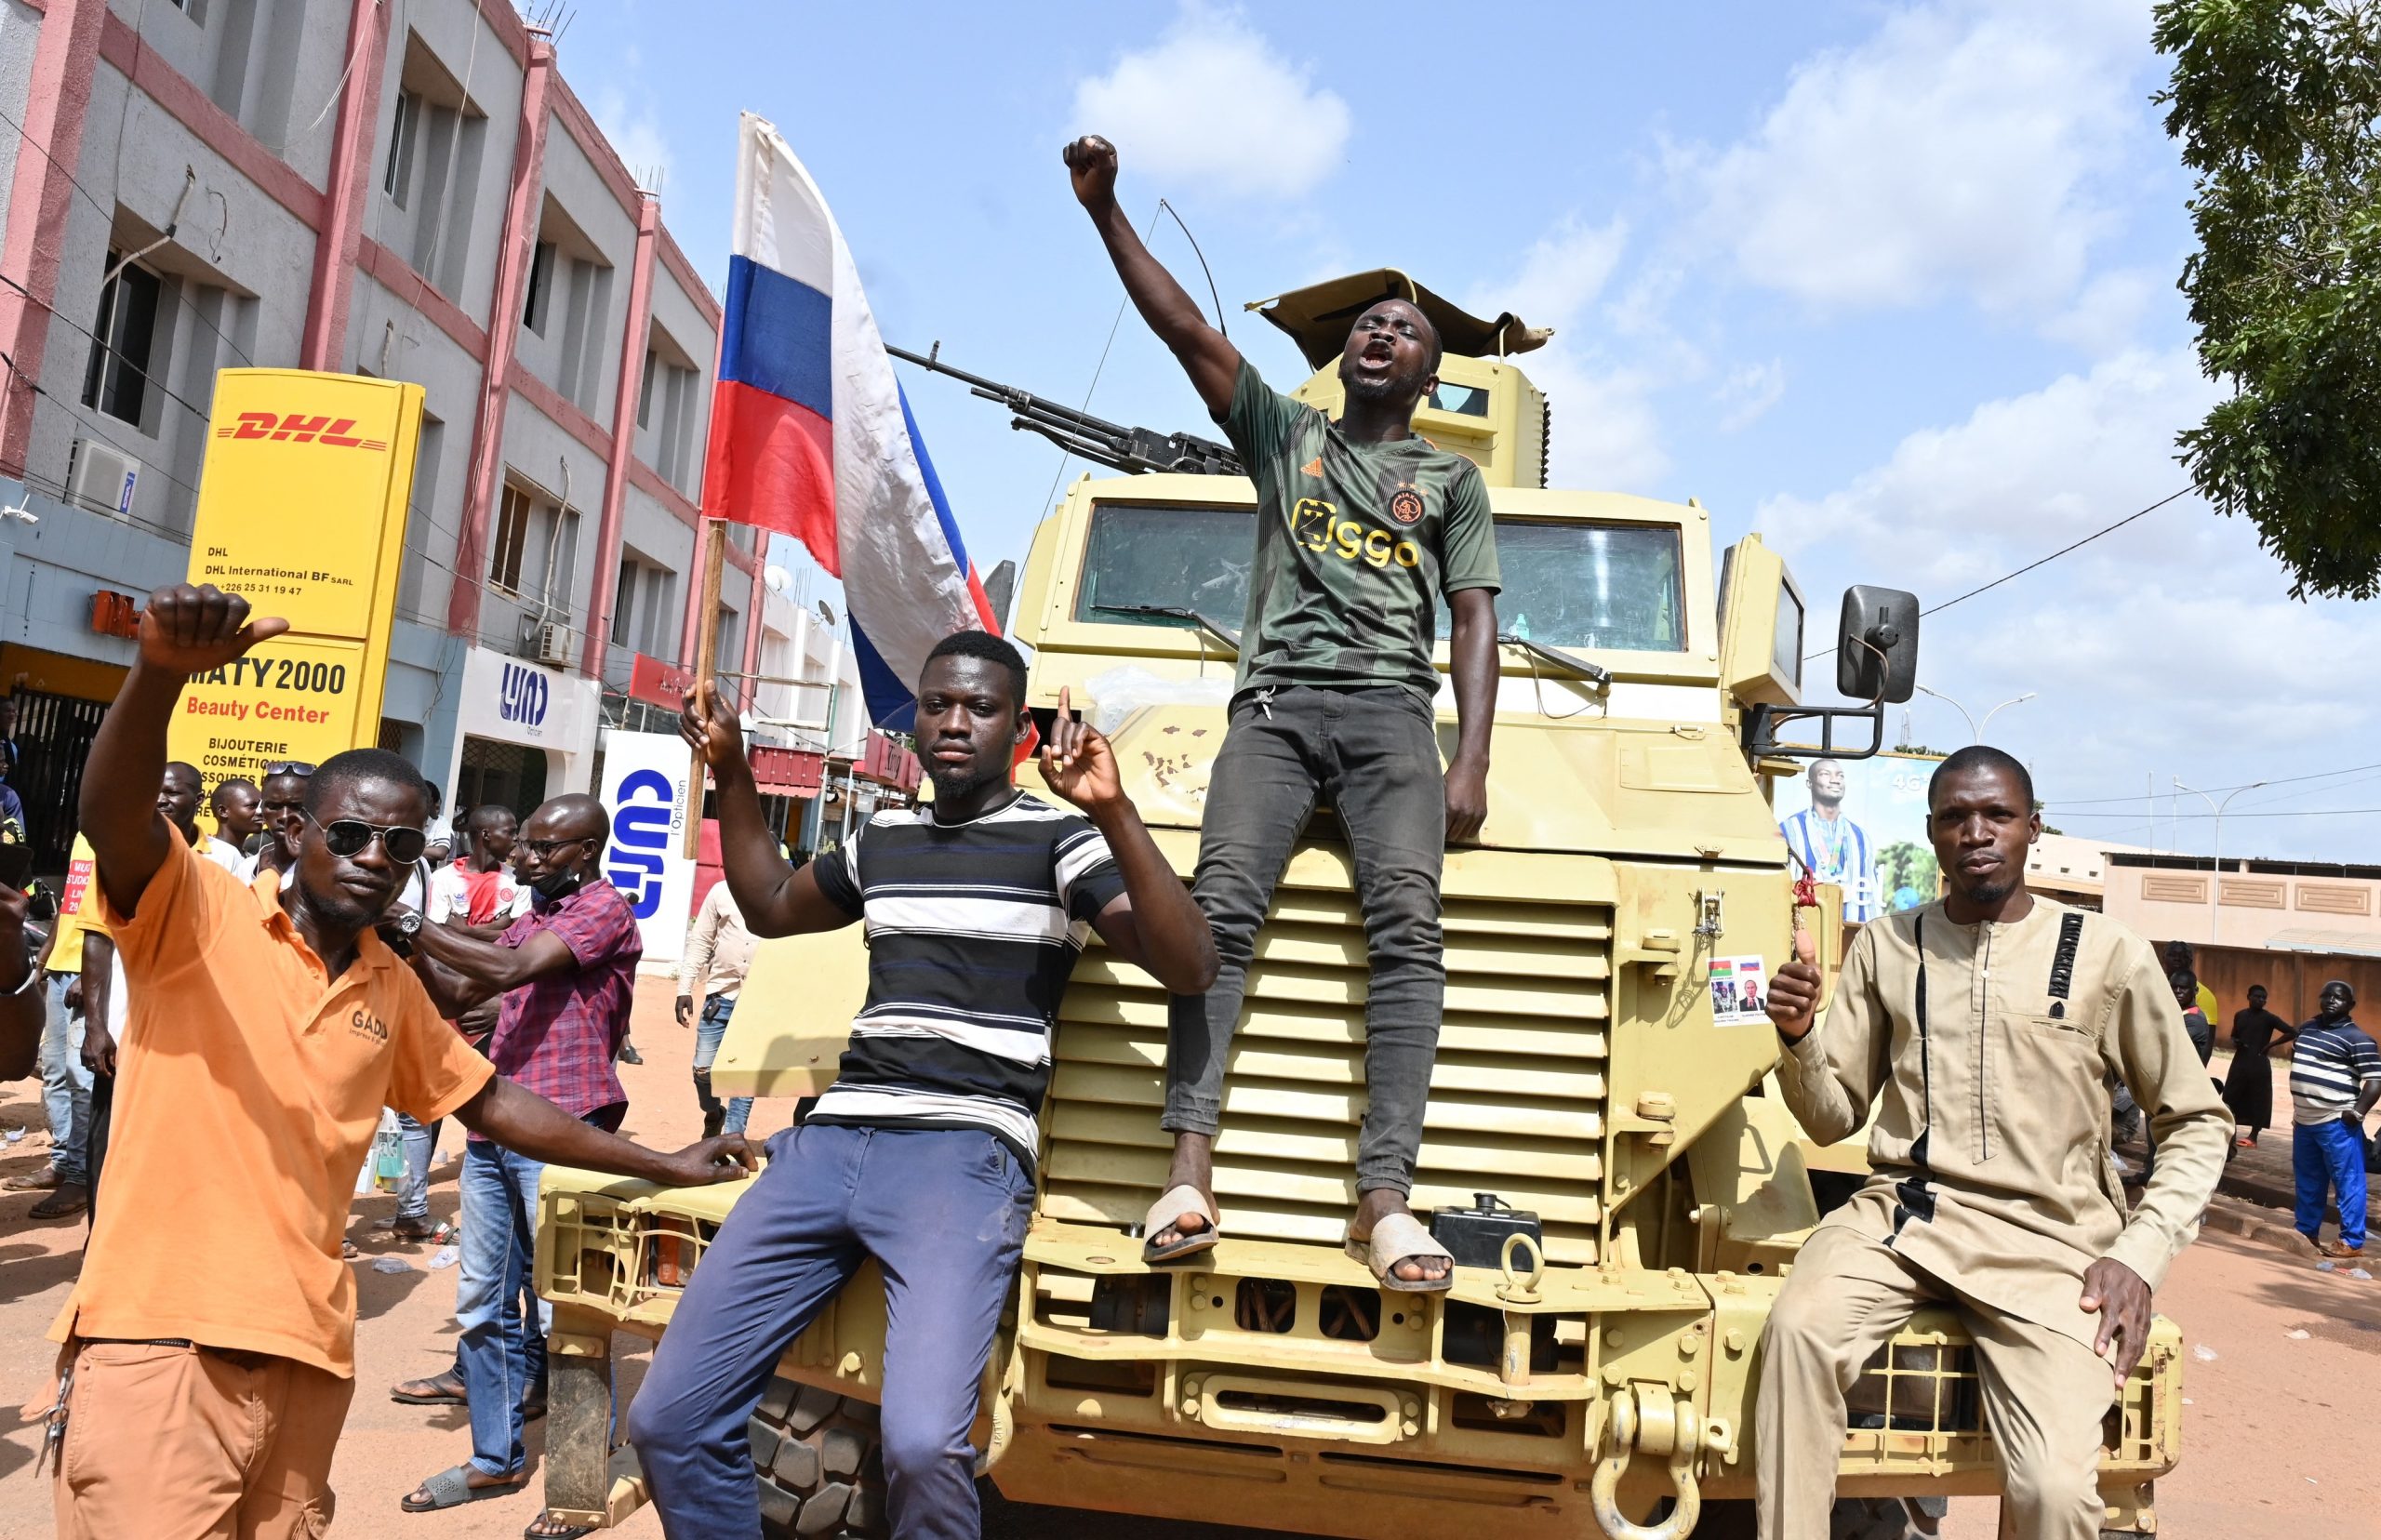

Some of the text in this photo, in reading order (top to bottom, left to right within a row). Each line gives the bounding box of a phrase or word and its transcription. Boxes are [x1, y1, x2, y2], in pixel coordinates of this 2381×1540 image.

[233, 412, 363, 447] DHL
[207, 547, 229, 557] DHL
[205, 565, 353, 586] DHL International BF SARL
[220, 583, 302, 596] +226 25 31 19 47
[276, 659, 346, 695] 2000
[187, 697, 329, 724] Beauty Center
[208, 737, 288, 754] BIJOUTERIE
[671, 779, 686, 836] l'Opticien
